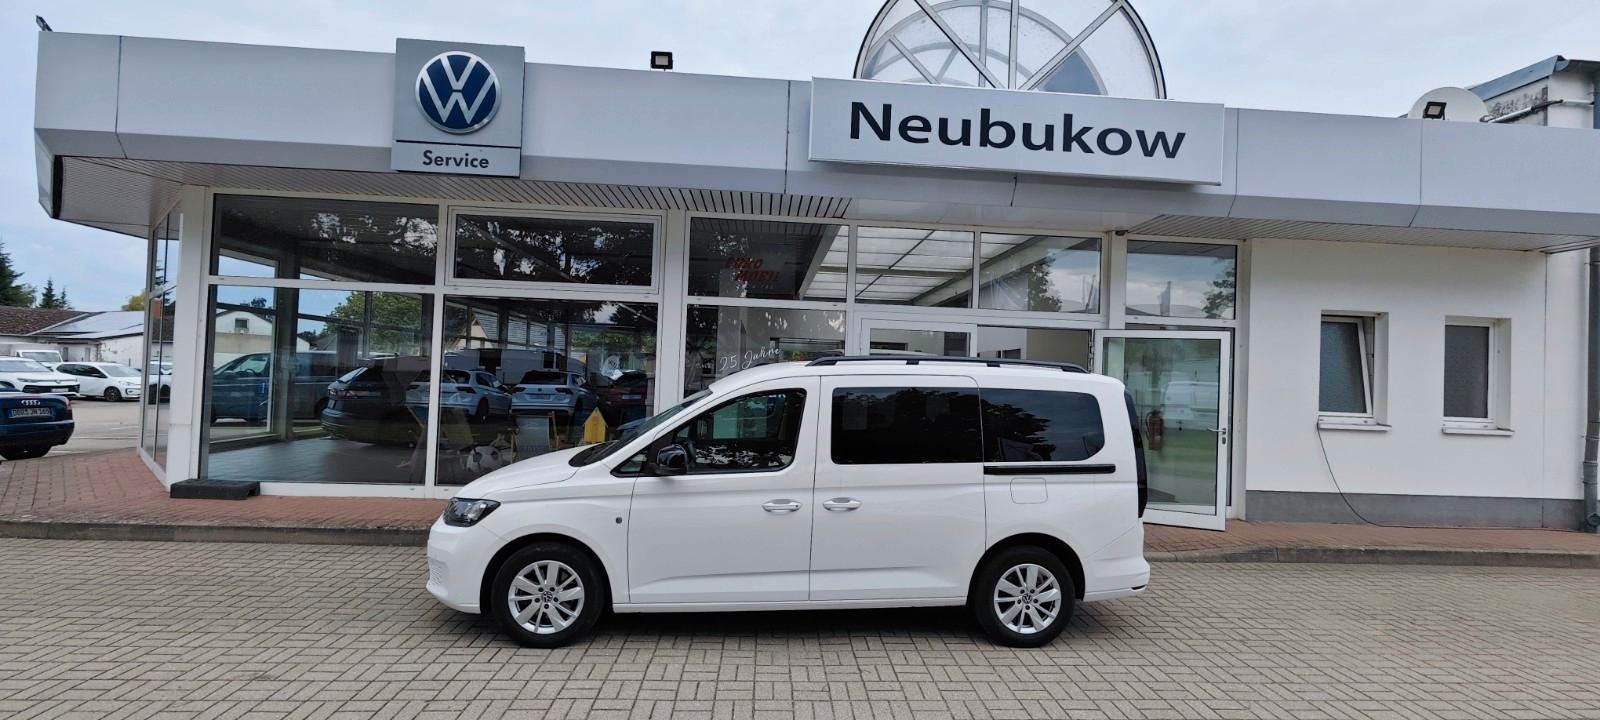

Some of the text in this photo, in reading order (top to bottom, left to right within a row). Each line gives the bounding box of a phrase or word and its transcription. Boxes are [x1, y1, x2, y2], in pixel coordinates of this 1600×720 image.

[849, 101, 1187, 159] Neubukow
[422, 149, 490, 169] Service
[719, 346, 780, 371] 25 Jahre
